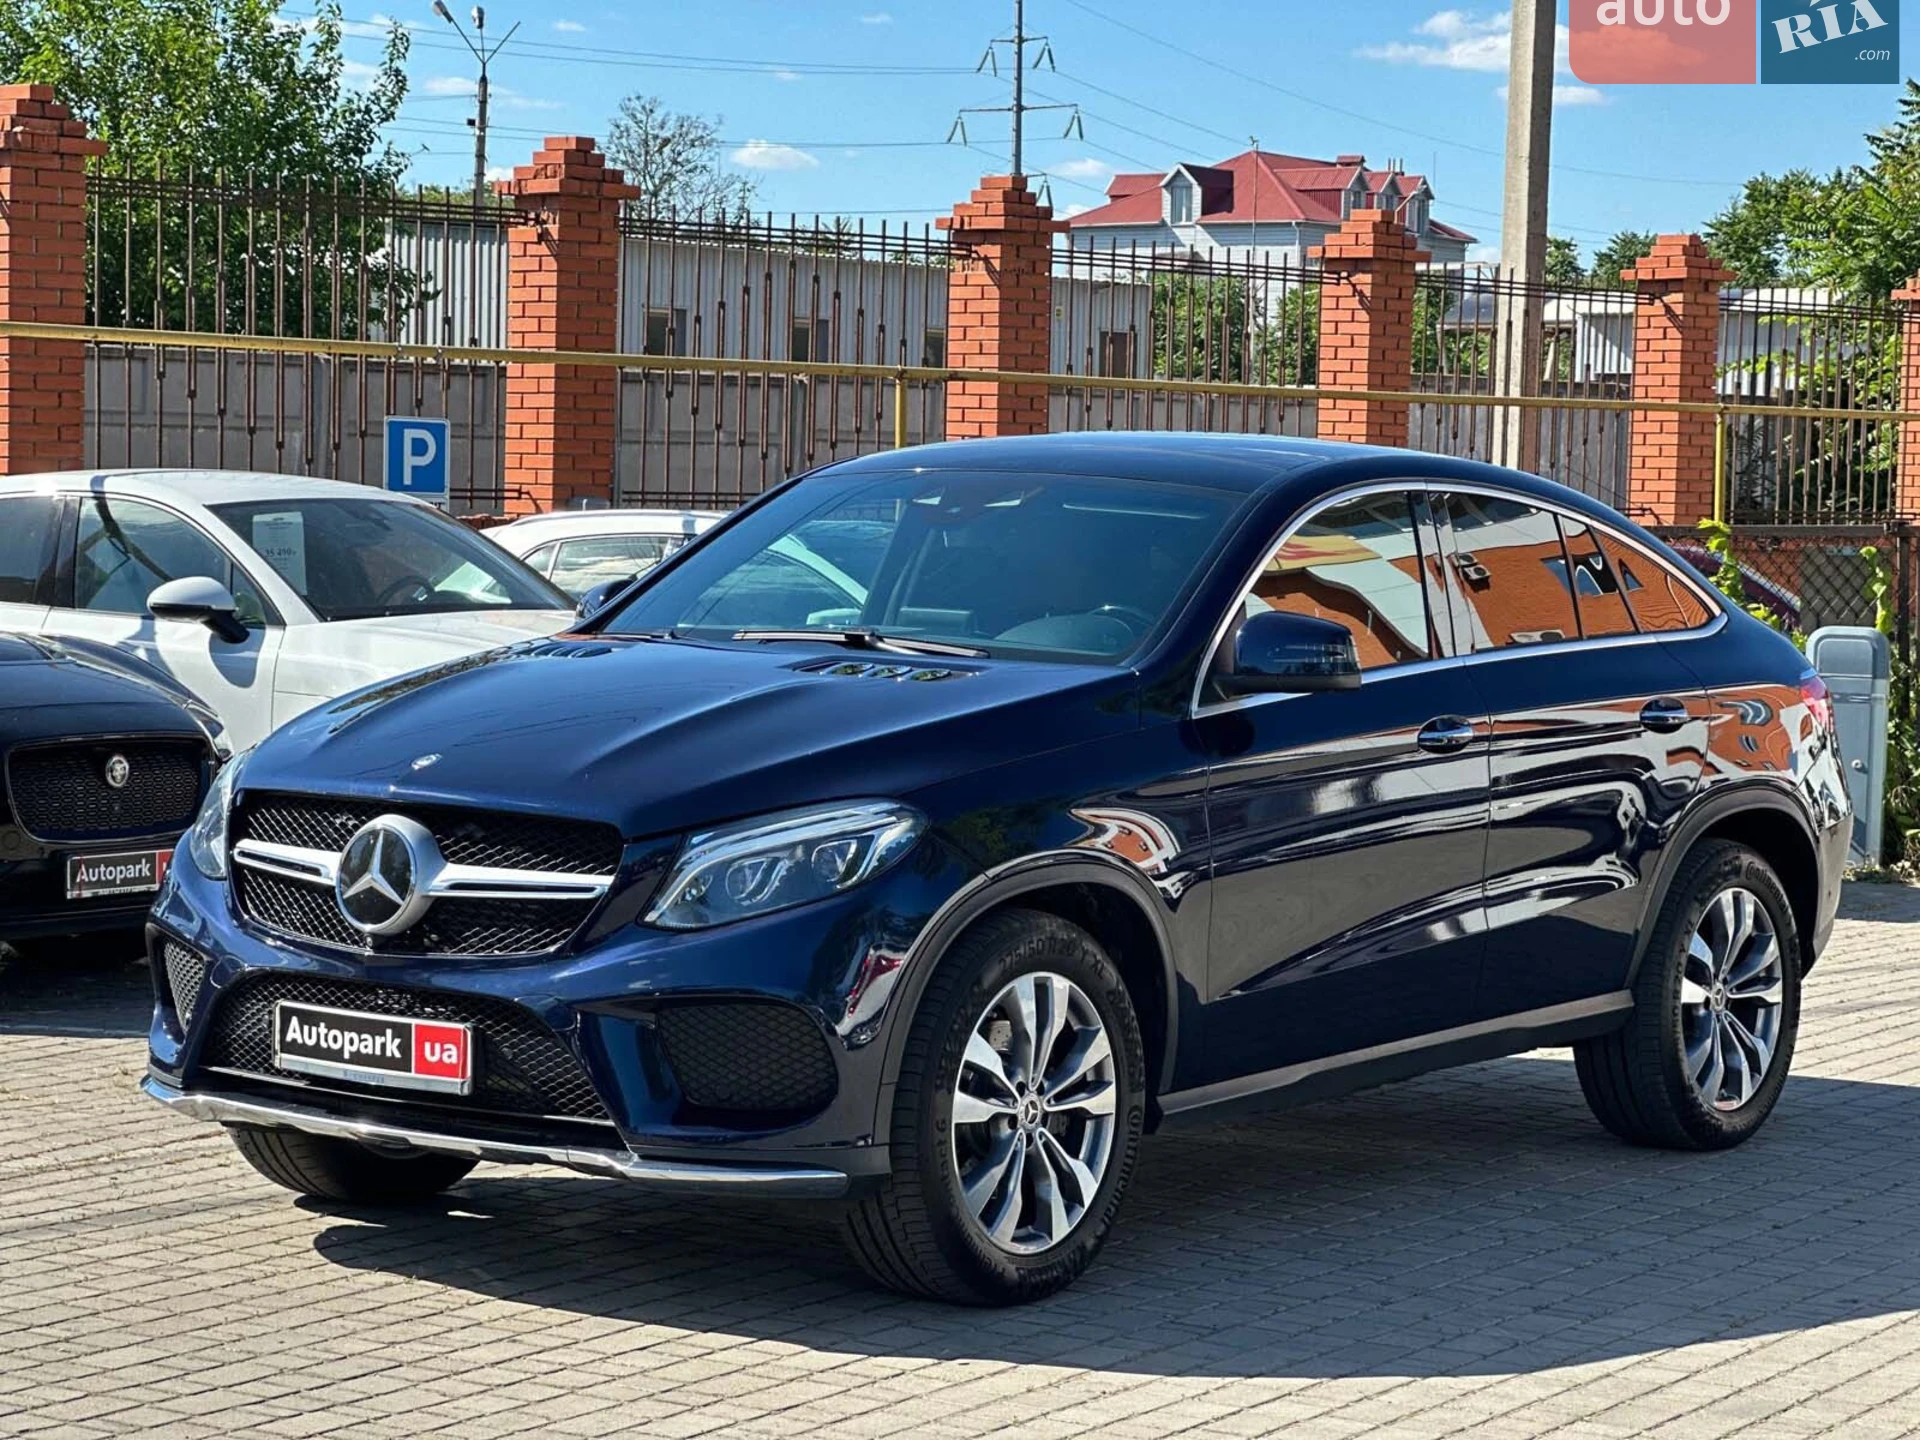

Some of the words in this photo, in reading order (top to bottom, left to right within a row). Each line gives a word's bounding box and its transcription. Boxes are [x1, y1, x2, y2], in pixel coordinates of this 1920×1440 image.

[403, 428, 436, 485] P
[76, 858, 151, 885] Autopark
[286, 1015, 402, 1060] Autopark
[424, 1041, 459, 1064] ua
